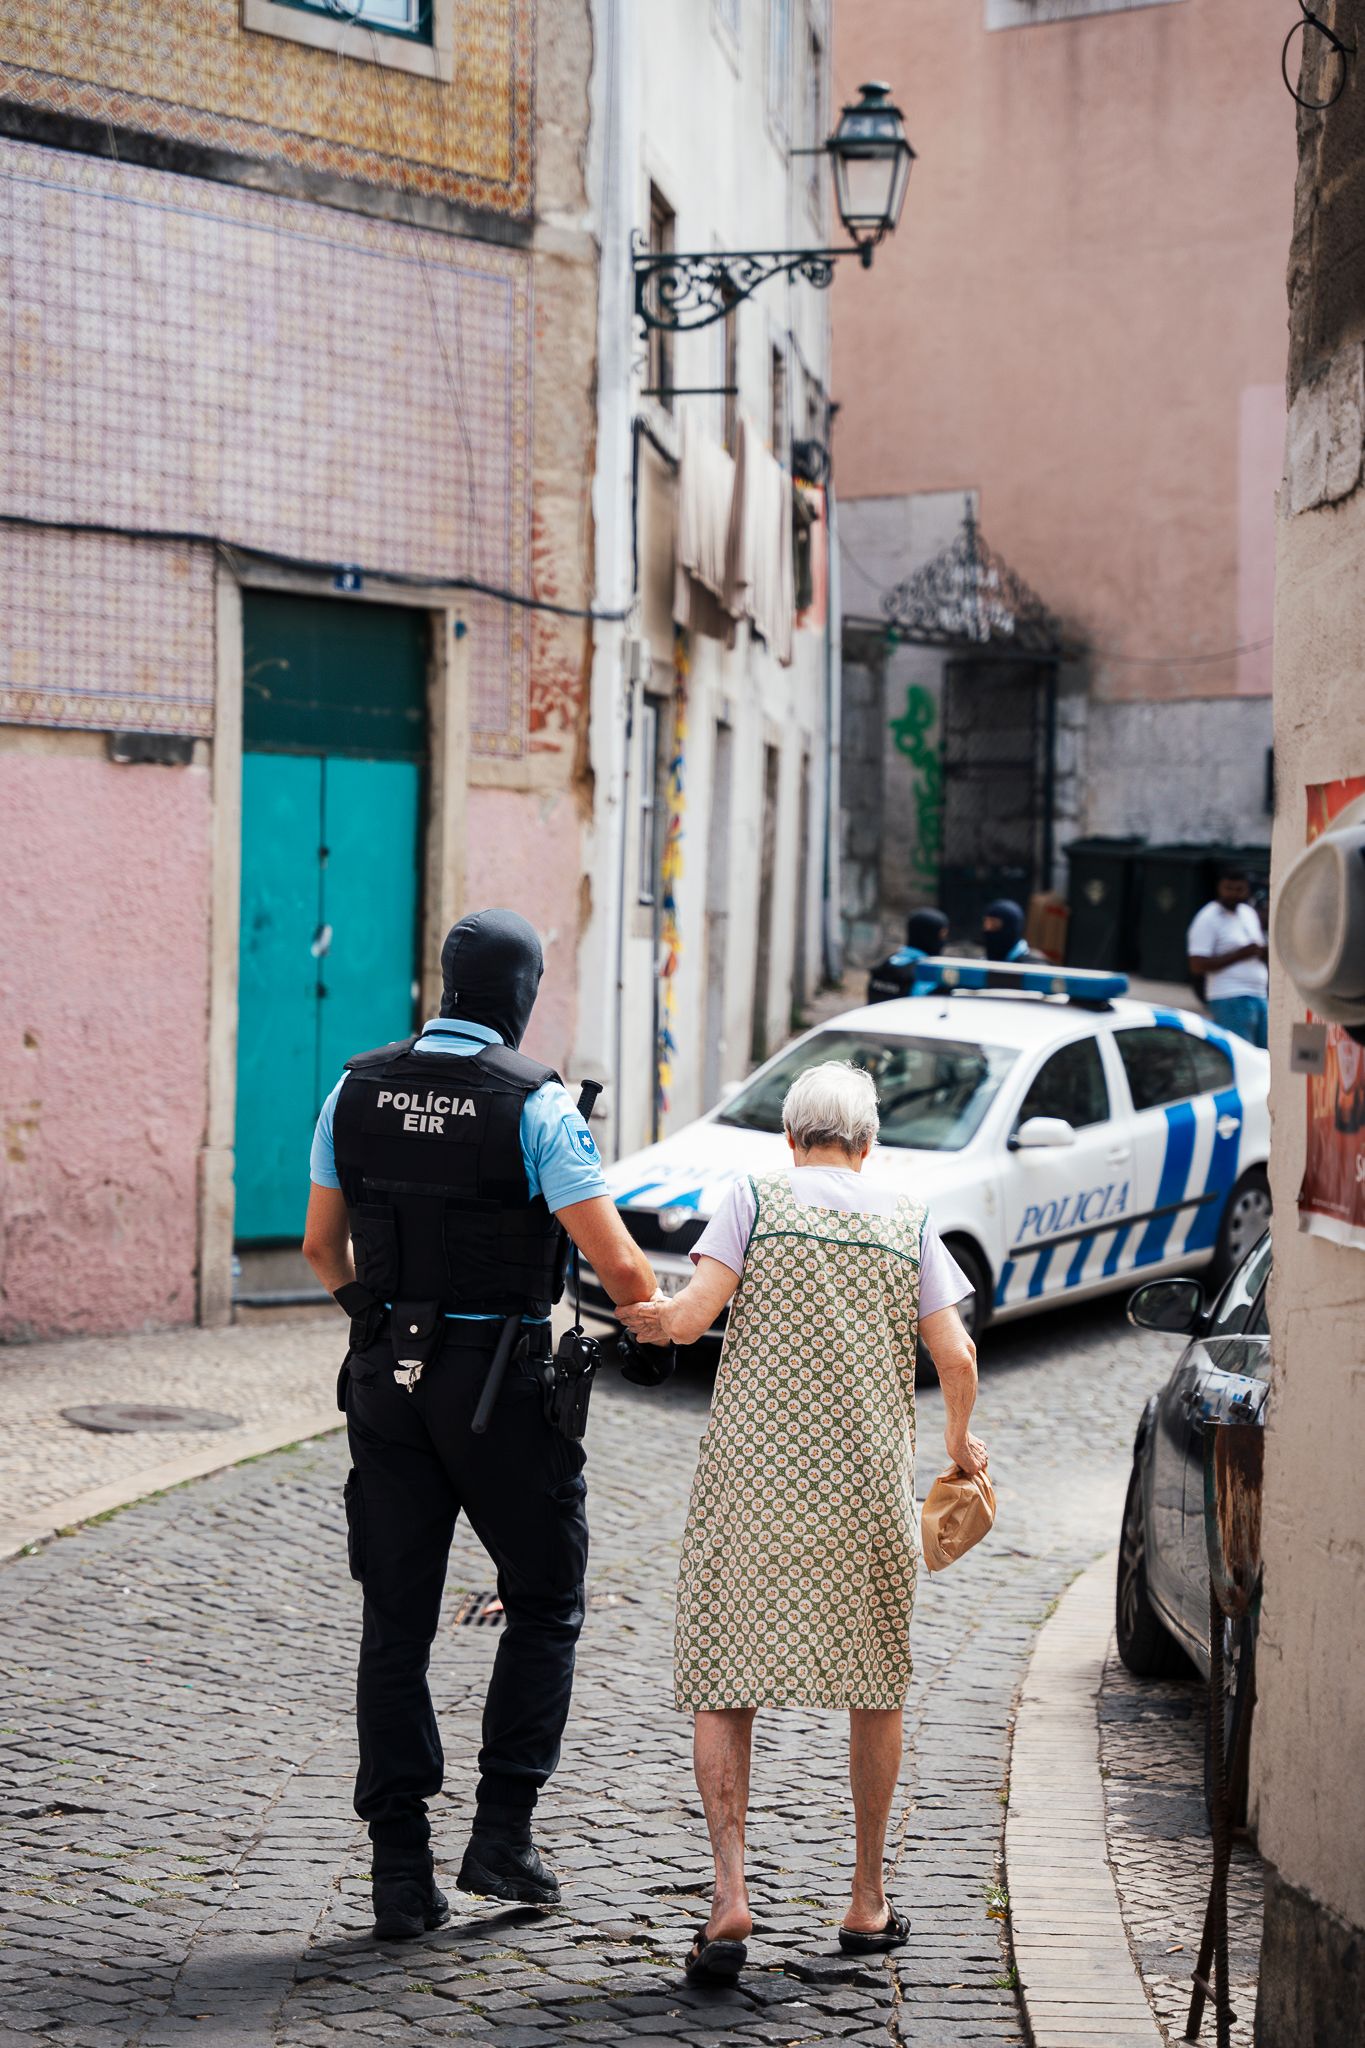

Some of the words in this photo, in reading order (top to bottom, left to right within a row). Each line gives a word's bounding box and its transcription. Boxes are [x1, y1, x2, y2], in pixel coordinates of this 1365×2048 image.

[377, 1091, 476, 1117] POLÍCIA
[403, 1113, 444, 1134] EIR
[1016, 1181, 1129, 1243] POLICIA
